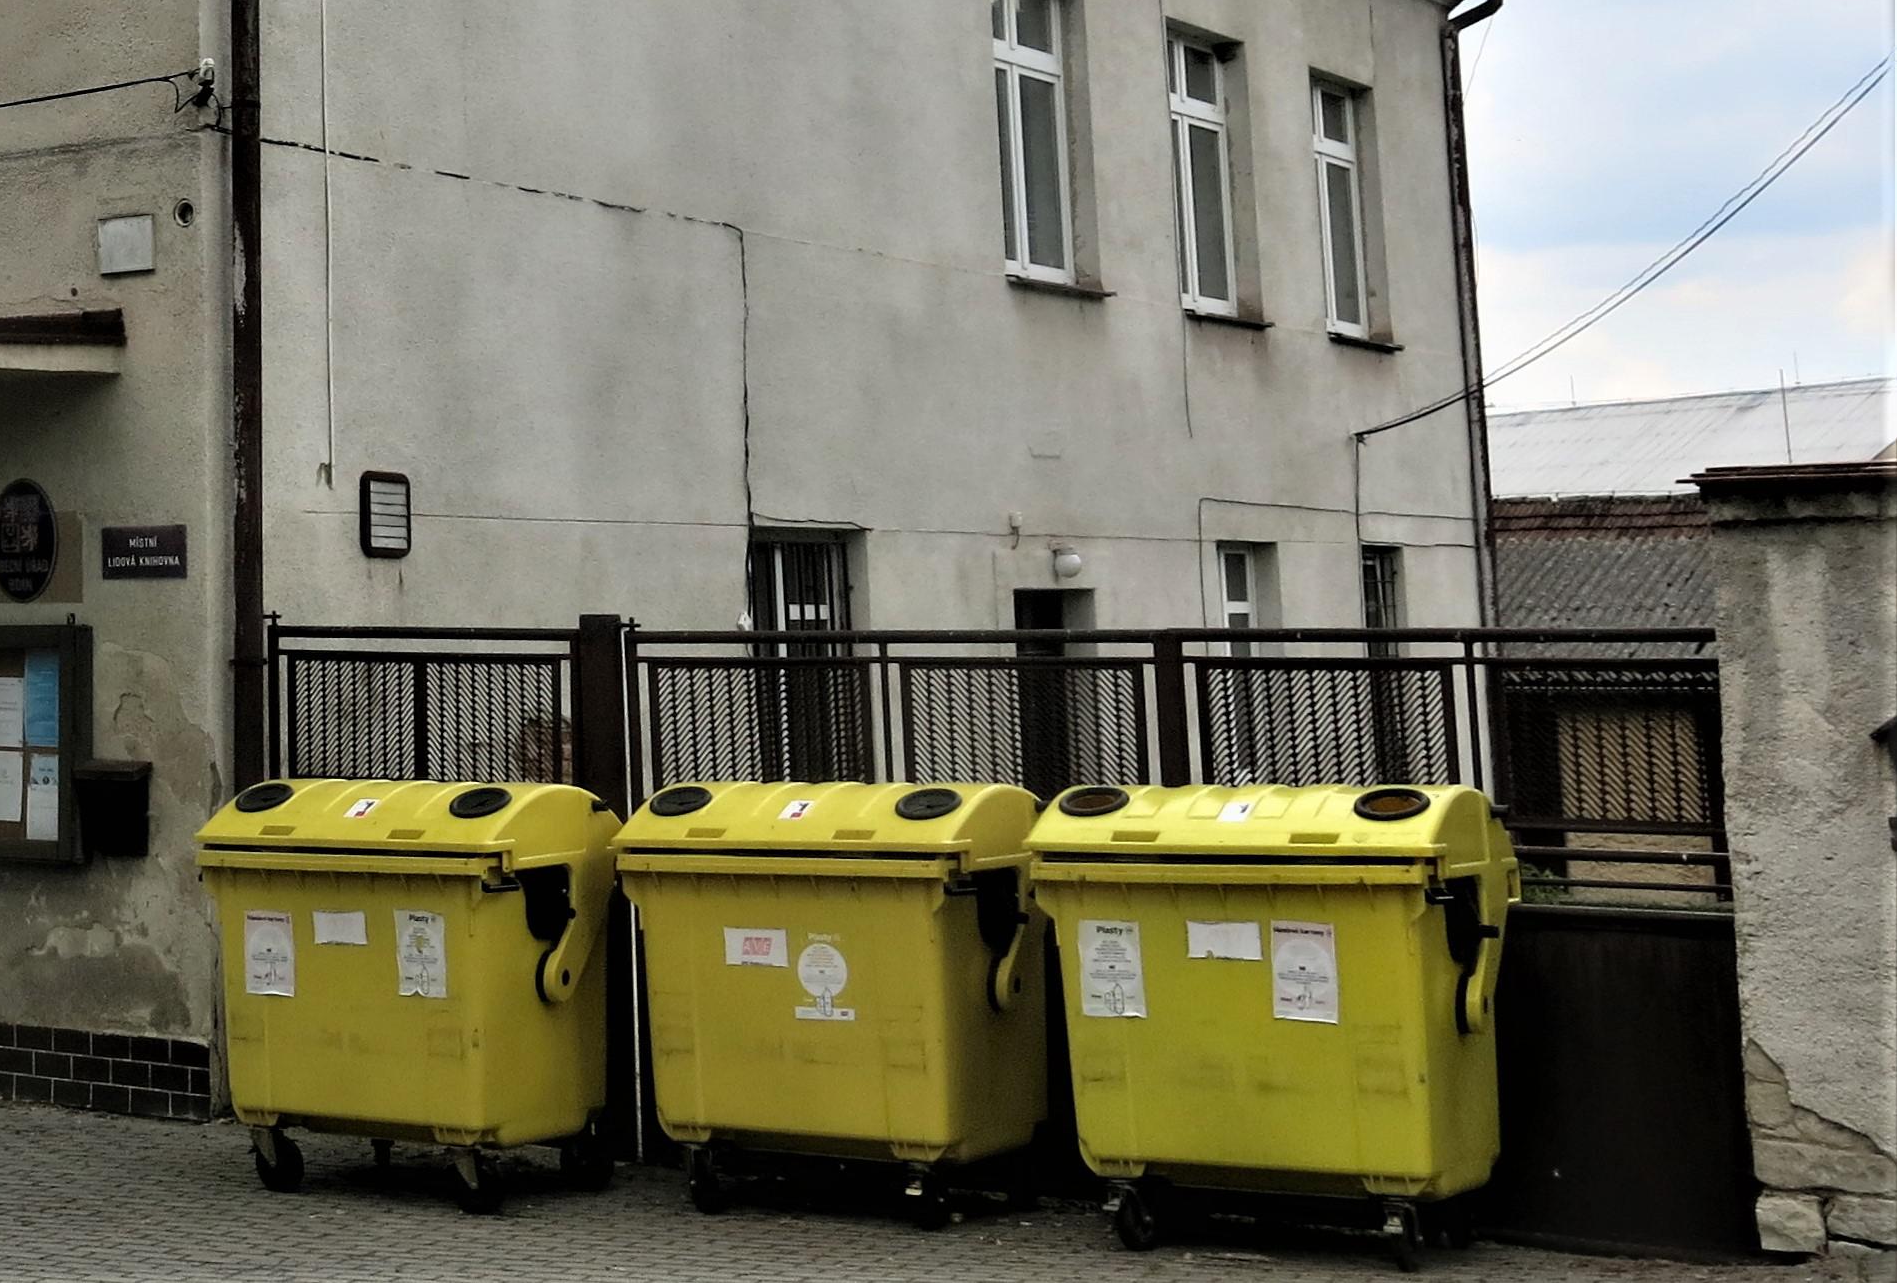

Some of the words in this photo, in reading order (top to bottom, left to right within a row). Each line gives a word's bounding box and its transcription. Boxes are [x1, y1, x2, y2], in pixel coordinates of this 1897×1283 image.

[129, 535, 158, 548] MÍSTNÍ
[108, 554, 136, 567] LIDOVÁ
[139, 555, 181, 566] KNIHOVNA
[1096, 925, 1123, 936] Plasty
